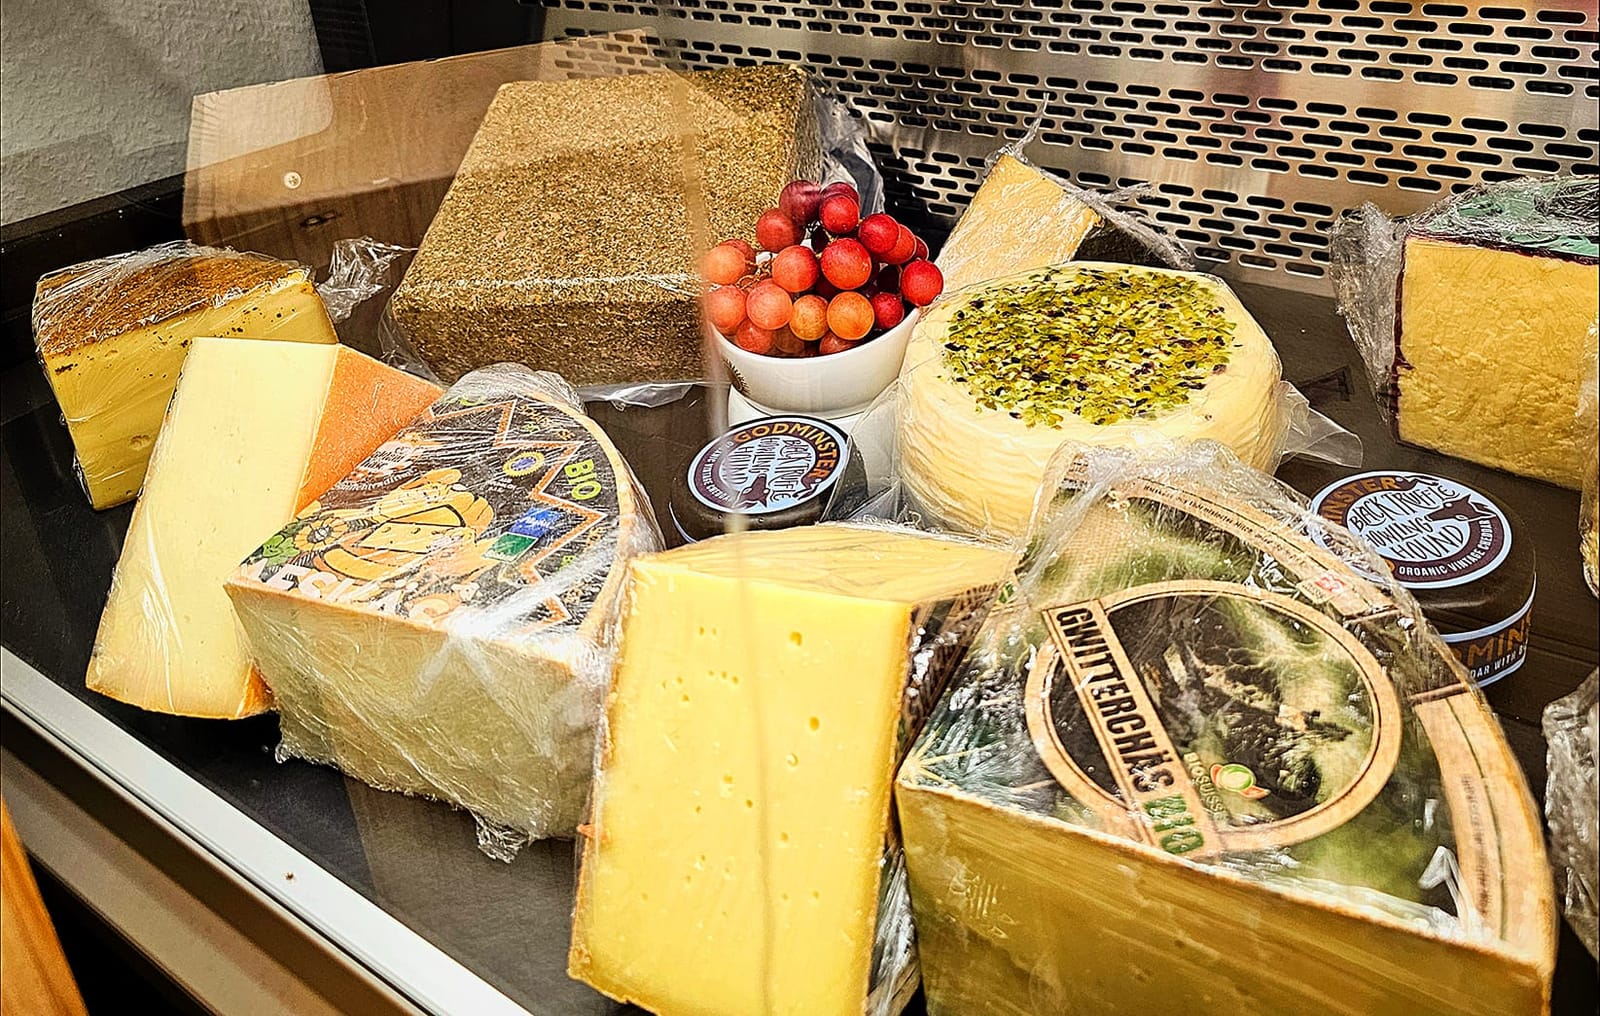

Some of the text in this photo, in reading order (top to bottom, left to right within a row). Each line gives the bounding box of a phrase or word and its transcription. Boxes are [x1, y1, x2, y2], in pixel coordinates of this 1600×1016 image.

[734, 422, 840, 479] GODMINSTER
[564, 459, 601, 500] BIO
[768, 462, 810, 502] TRUFFLE
[1322, 477, 1402, 525] INSTER
[1349, 484, 1460, 532] BLACK TRUFFLE
[1390, 525, 1464, 560] HOUND
[1399, 518, 1493, 577] ORGANIC VINTAGE CHEDDAR
[1494, 651, 1516, 670] WITH
[1143, 793, 1204, 854] BIO
